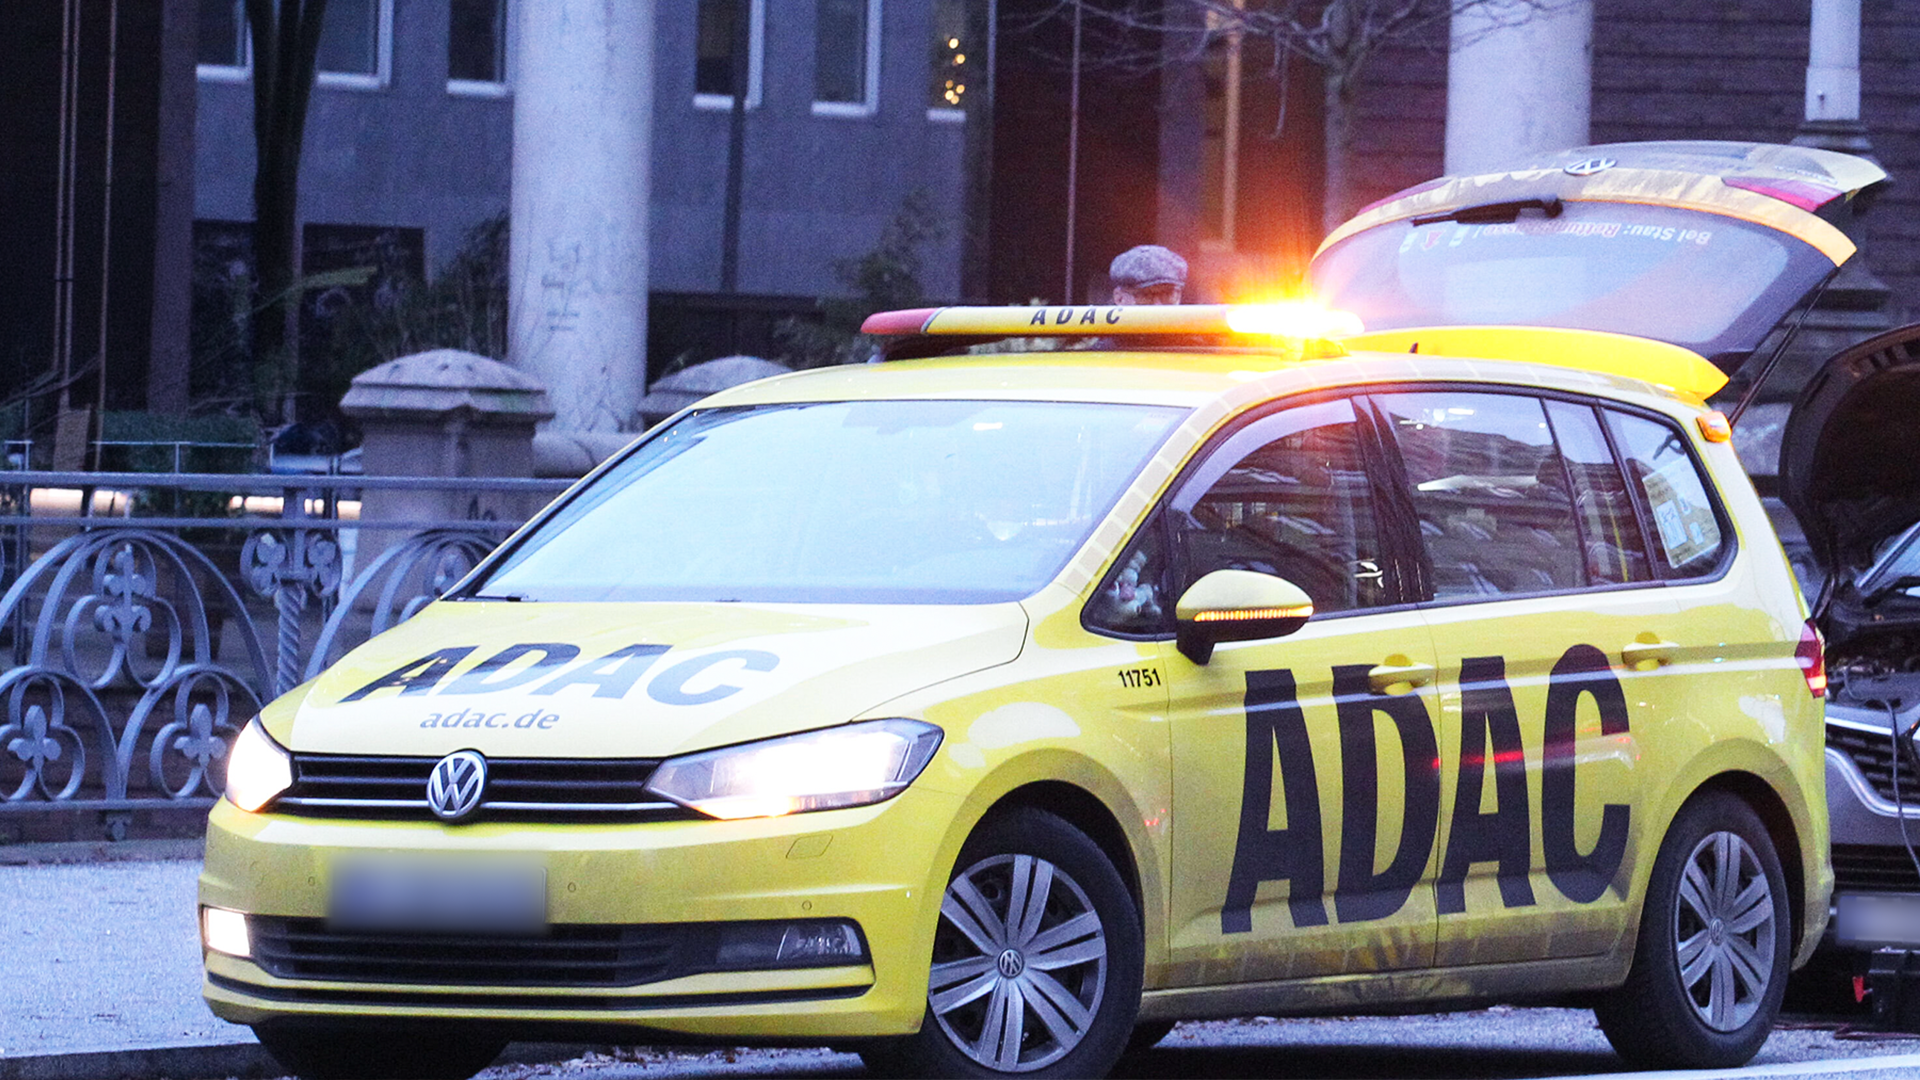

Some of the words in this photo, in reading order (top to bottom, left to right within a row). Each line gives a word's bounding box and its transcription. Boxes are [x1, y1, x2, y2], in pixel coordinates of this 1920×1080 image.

[1029, 307, 1124, 326] ADAC
[337, 643, 780, 706] ADAC
[1117, 668, 1162, 688] 11751
[419, 707, 560, 730] adac.de
[1221, 644, 1631, 935] ADAC
